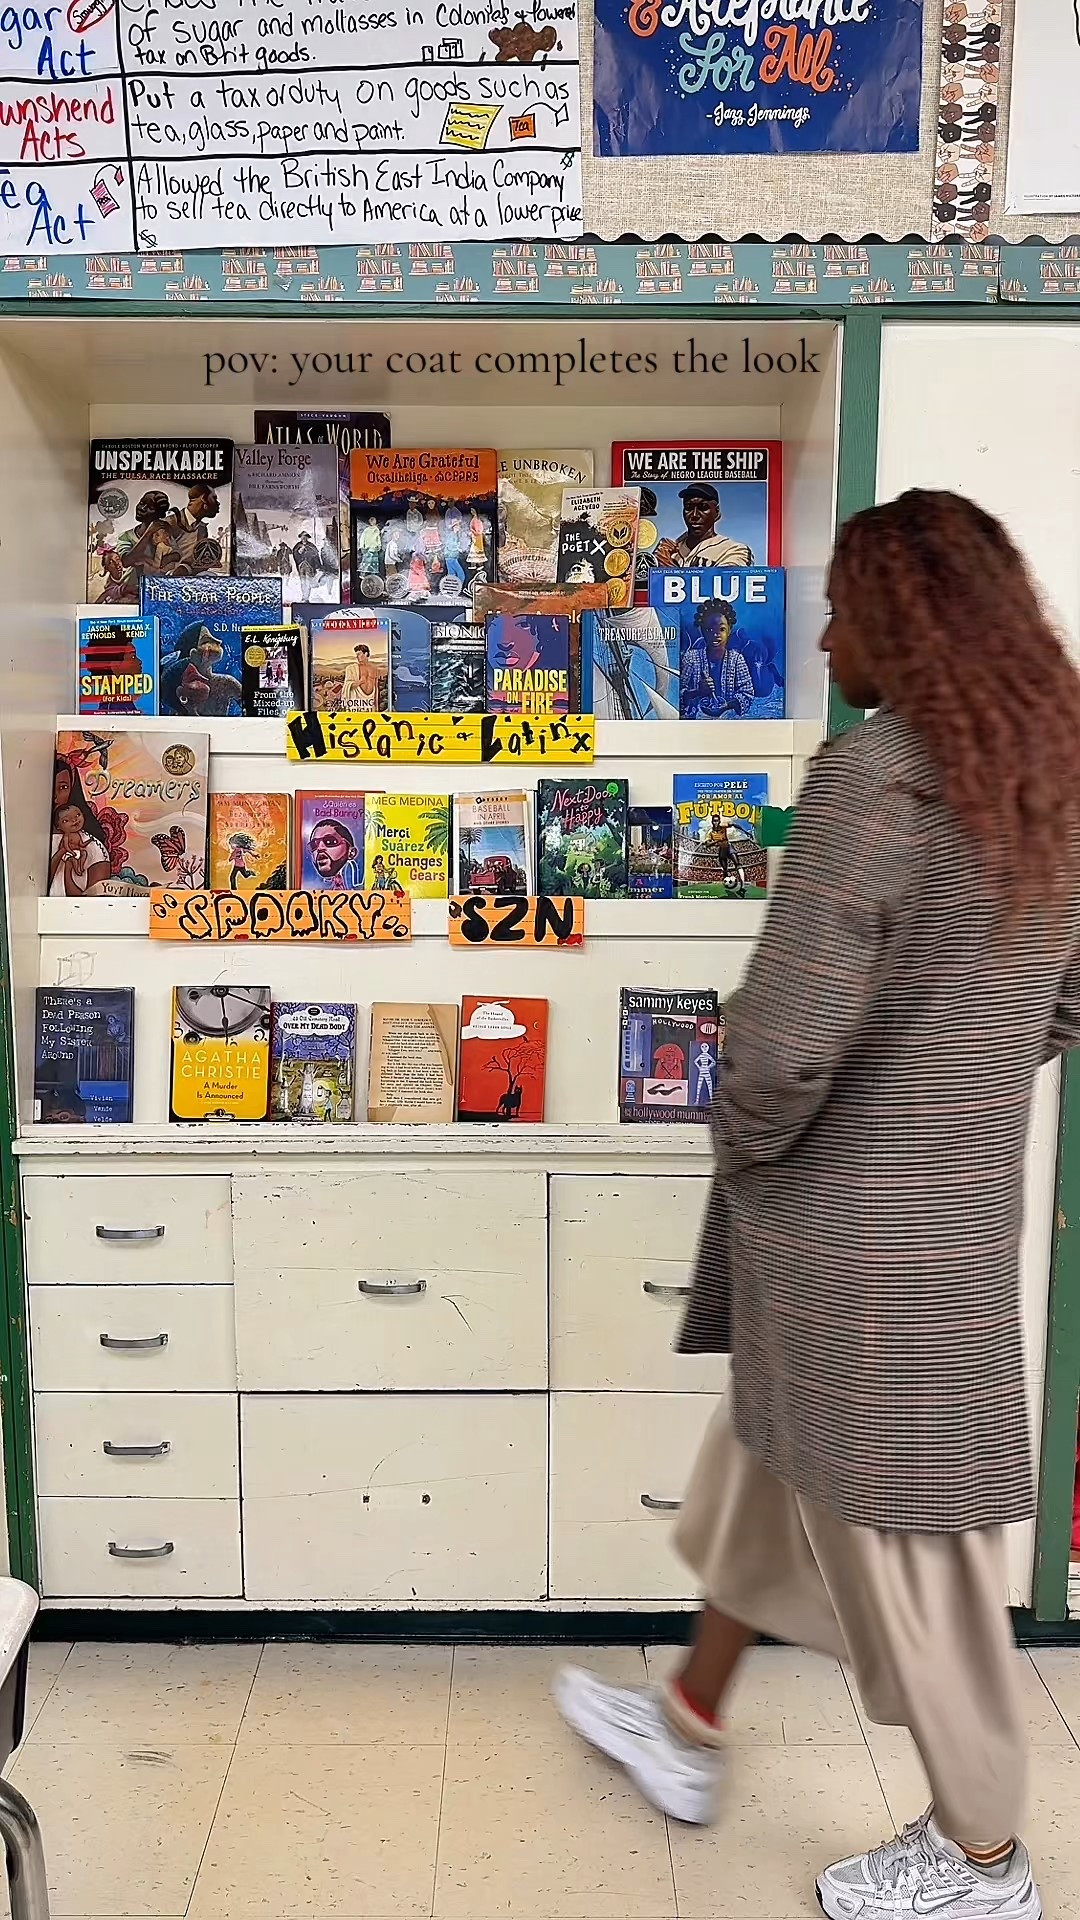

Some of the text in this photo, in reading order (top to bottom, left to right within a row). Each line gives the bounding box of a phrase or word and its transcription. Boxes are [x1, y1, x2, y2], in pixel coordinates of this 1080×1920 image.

[129, 9, 159, 46] of
[172, 19, 244, 52] sugar
[258, 12, 294, 37] and
[301, 9, 398, 35] mollasses
[407, 9, 424, 26] in
[38, 36, 97, 80] Act
[135, 47, 167, 65] tax
[176, 50, 198, 66] on
[200, 43, 250, 66] Brit
[678, 24, 836, 93] For All
[128, 79, 175, 109] Put
[190, 91, 206, 109] a
[216, 79, 261, 108] tax
[357, 80, 394, 104] on
[405, 71, 471, 118] goods
[747, 104, 811, 128] Jennings
[313, 119, 349, 143] and
[511, 119, 531, 133] Tea
[20, 119, 86, 161] Acts
[137, 158, 565, 202] Allowed the British East India Company
[136, 199, 158, 221] to
[166, 197, 203, 220] sell
[212, 197, 252, 221] tea
[258, 190, 334, 232] directly
[338, 194, 356, 217] to
[363, 197, 443, 227] America
[26, 201, 96, 246] Act
[94, 450, 224, 471] UNSPEAKABLE
[236, 448, 312, 471] Valley Forge
[365, 451, 480, 470] We Are Grateful
[628, 451, 764, 470] WE ARE THE SHIP
[119, 472, 147, 480] TULSA
[149, 472, 172, 480] RACE
[173, 472, 219, 480] MASSACRE
[513, 459, 587, 485] UNBROKEN
[671, 471, 695, 479] NEGRO
[697, 471, 723, 479] LEAGUE
[724, 470, 757, 479] BASEBALL
[571, 496, 601, 506] ELIZABETH
[573, 503, 600, 511] ACEVEDO
[565, 532, 581, 541] THE
[590, 538, 608, 556] X
[148, 585, 272, 604] THE STAR PEOPLE
[664, 575, 767, 603] BLUE
[81, 632, 116, 640] REYNOLDS
[598, 626, 677, 641] TREASURE ISLAND
[81, 674, 153, 696] STAMPED
[493, 668, 567, 692] PARADISE
[254, 690, 294, 699] From the
[324, 699, 374, 707] EXPLORING
[506, 692, 555, 714] ON FIRE
[253, 699, 295, 709] Mixed-up
[257, 708, 279, 716] Files
[288, 712, 592, 764] Hispanic Latinx
[85, 769, 202, 816] Dreamers
[724, 779, 748, 789] PELÉ
[372, 797, 443, 806] MEG MEDINA
[473, 804, 511, 812] BASEBALL
[550, 788, 584, 812] Next
[315, 808, 331, 817] Bad
[488, 812, 506, 820] APRIL
[564, 807, 603, 830] Happy
[377, 825, 410, 838] Merci
[382, 839, 424, 851] Suárez
[388, 854, 443, 870] Changes
[410, 868, 445, 881] Gears
[179, 890, 385, 940] SPOOKY
[461, 895, 574, 943] SZN
[628, 995, 713, 1014] sammy keyes
[652, 1018, 694, 1030] HOLLYWOOD
[41, 1036, 55, 1048] My
[182, 1050, 260, 1063] AGATHA
[181, 1065, 260, 1079] CHRISTIE
[205, 1091, 244, 1099] Announced
[633, 1107, 676, 1119] hollywood
